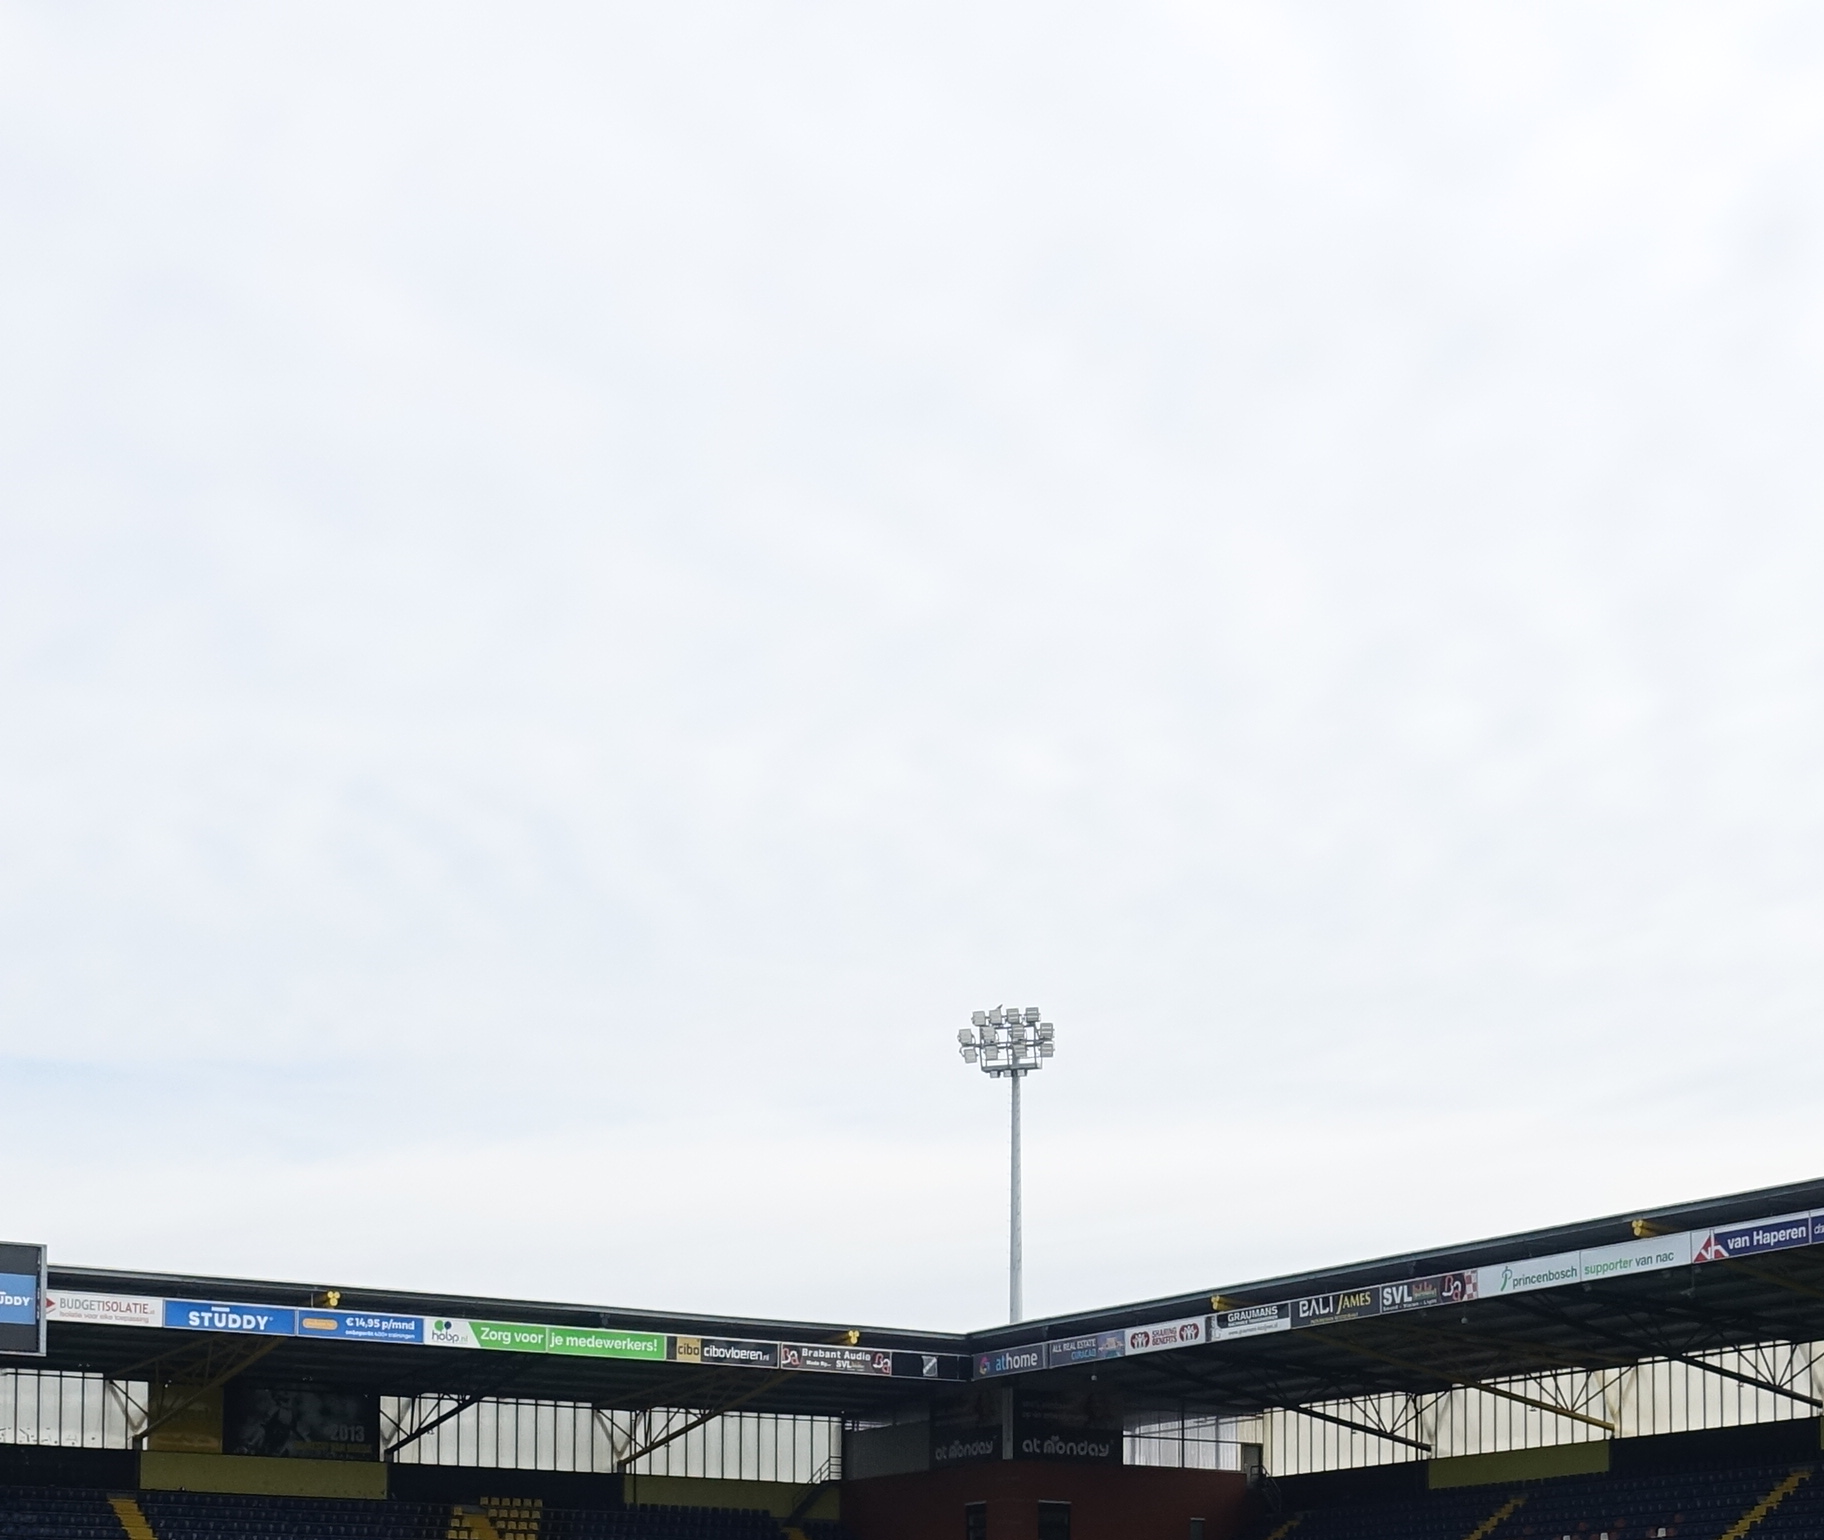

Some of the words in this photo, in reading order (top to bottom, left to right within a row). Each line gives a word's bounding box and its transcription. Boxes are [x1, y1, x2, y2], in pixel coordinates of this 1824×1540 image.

[1727, 1235, 1751, 1250] van
[1753, 1225, 1807, 1247] Haperen
[1584, 1257, 1633, 1276] supporter
[1635, 1254, 1653, 1267] van
[1656, 1251, 1675, 1264] nac
[1512, 1265, 1578, 1289] princenbosch
[1383, 1284, 1413, 1306] SVL
[1299, 1295, 1334, 1318] BALI
[1336, 1291, 1372, 1315] JAMES
[1227, 1306, 1278, 1323] GRAUMANS
[382, 1320, 415, 1331] p/mnd
[480, 1327, 511, 1344] Zorg
[514, 1331, 544, 1344] voor
[549, 1328, 563, 1348] je
[566, 1329, 658, 1352] medewerkers!
[1052, 1343, 1062, 1353] ALL
[1062, 1340, 1076, 1352] REAL
[1077, 1338, 1096, 1350] ESTATE
[677, 1343, 700, 1356] cibo
[703, 1344, 770, 1362] cibovloeren.nl
[802, 1347, 841, 1358] Brabant
[844, 1350, 871, 1361] Audio
[996, 1352, 1039, 1372] athome
[330, 1424, 365, 1442] 2013
[1022, 1438, 1040, 1453] at
